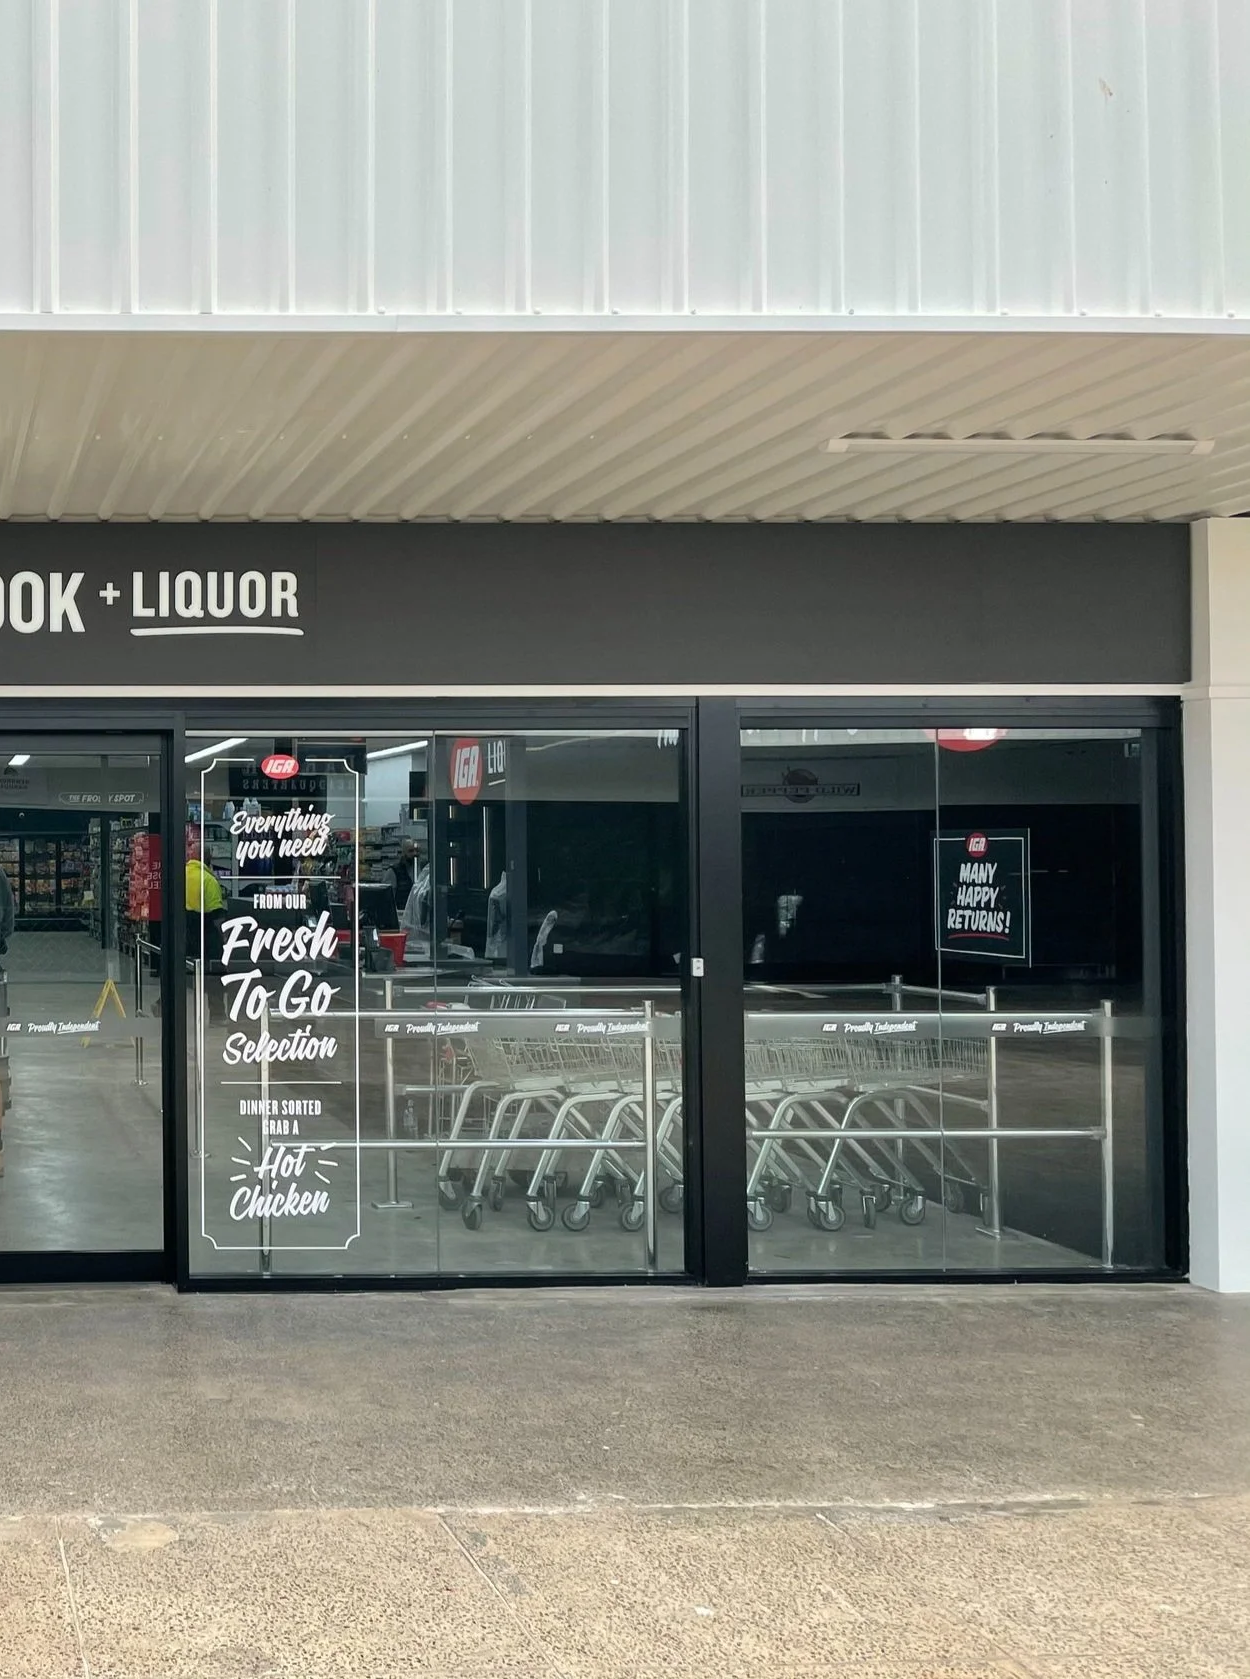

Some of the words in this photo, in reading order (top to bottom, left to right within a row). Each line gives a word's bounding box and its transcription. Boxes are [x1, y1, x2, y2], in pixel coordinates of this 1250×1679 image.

[132, 570, 298, 619] LIQUOR
[265, 758, 296, 774] IGA
[453, 745, 480, 789] IGA
[487, 740, 506, 774] LIQ
[81, 794, 113, 803] FROY
[113, 794, 136, 803] SPOT
[230, 804, 336, 837] Everything
[236, 841, 274, 867] you
[278, 835, 328, 860] need
[968, 837, 986, 852] IGA
[959, 862, 998, 884] MANY
[253, 894, 282, 910] FROM
[285, 894, 307, 910] OUR
[956, 884, 999, 908] HAPPY
[947, 908, 1011, 934] RETURNS!
[221, 910, 339, 967] Fresh
[220, 968, 276, 1022] To
[278, 969, 341, 1020] Go
[6, 1022, 22, 1032] IGA
[27, 1021, 57, 1034] Proudly
[57, 1020, 101, 1034] Independent
[385, 1023, 400, 1032] IGA
[406, 1022, 436, 1034] Proudly
[436, 1020, 481, 1034] Independent
[555, 1023, 571, 1032] IGA
[576, 1022, 607, 1034] Proudly
[607, 1020, 651, 1034] Independent
[822, 1023, 838, 1032] IGA
[843, 1022, 874, 1034] Proudly
[874, 1020, 918, 1034] Independent
[991, 1023, 1007, 1032] IGA
[1013, 1022, 1043, 1034] Proudly
[1042, 1020, 1088, 1034] Independent
[222, 1025, 338, 1065] Selection
[239, 1100, 279, 1116] DINNER
[281, 1100, 322, 1116] SORTED
[262, 1120, 290, 1136] GRAB
[291, 1120, 300, 1136] A
[253, 1144, 316, 1180] Hot
[229, 1180, 331, 1221] Chicken
